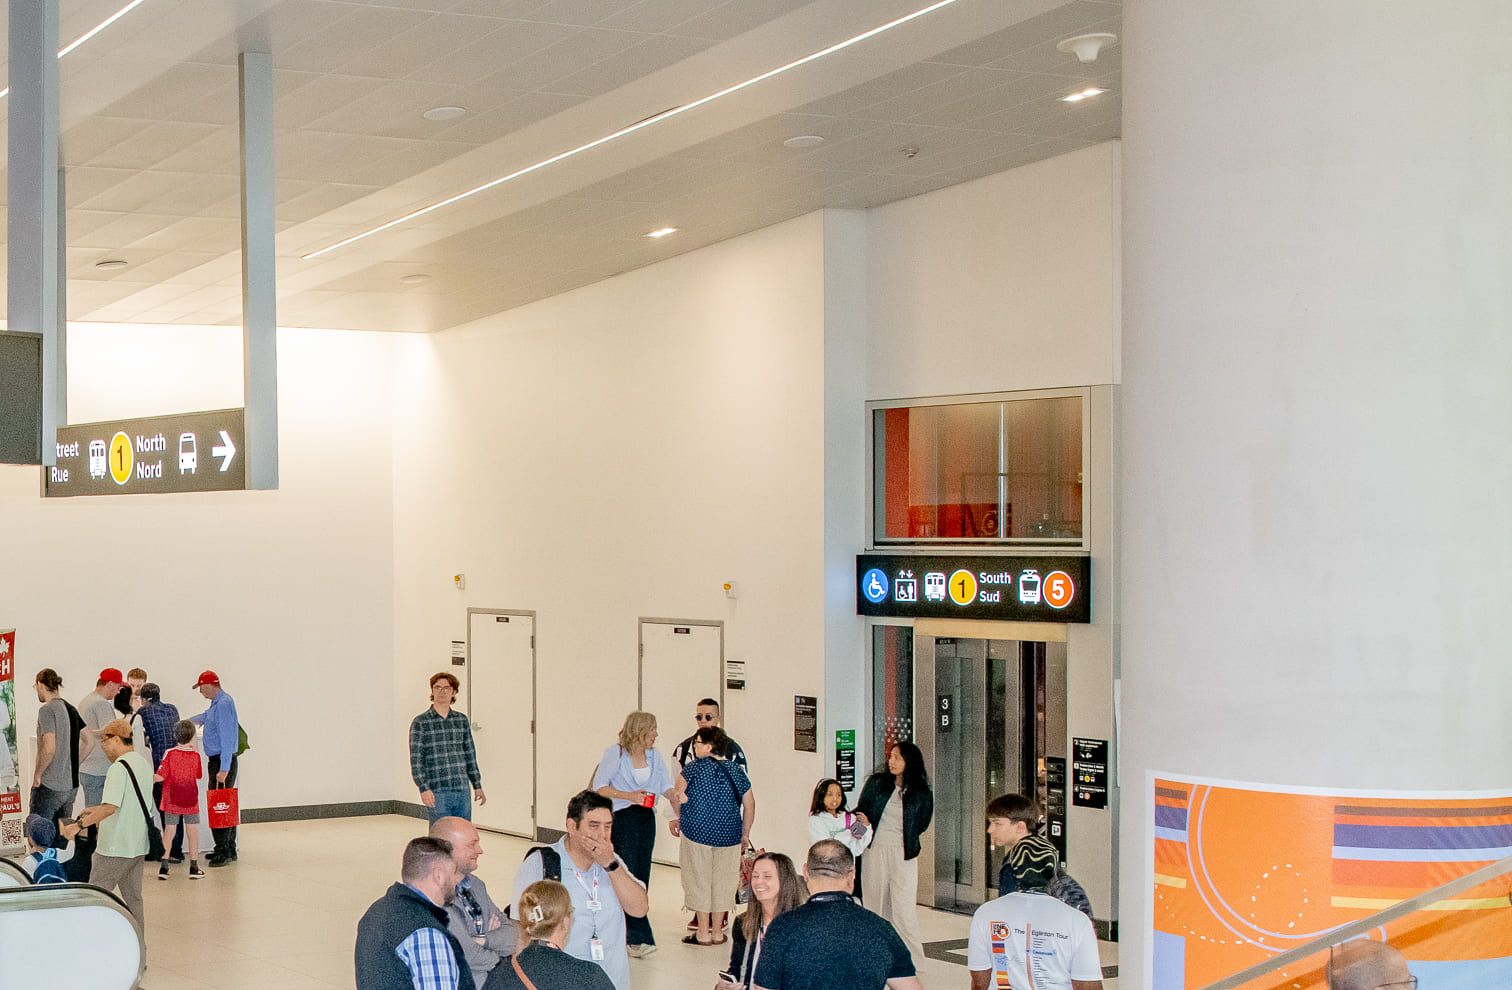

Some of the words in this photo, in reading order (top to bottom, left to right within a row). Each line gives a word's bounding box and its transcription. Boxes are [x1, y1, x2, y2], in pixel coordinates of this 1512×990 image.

[56, 441, 79, 458] treet
[136, 433, 166, 453] North
[116, 445, 124, 471] 1
[51, 466, 69, 483] Rue
[136, 460, 162, 479] Nord
[979, 572, 1011, 585] South
[958, 579, 966, 598] 1
[979, 590, 1001, 603] Sud
[1051, 579, 1065, 600] 5
[942, 698, 949, 709] 3
[941, 715, 949, 726] B
